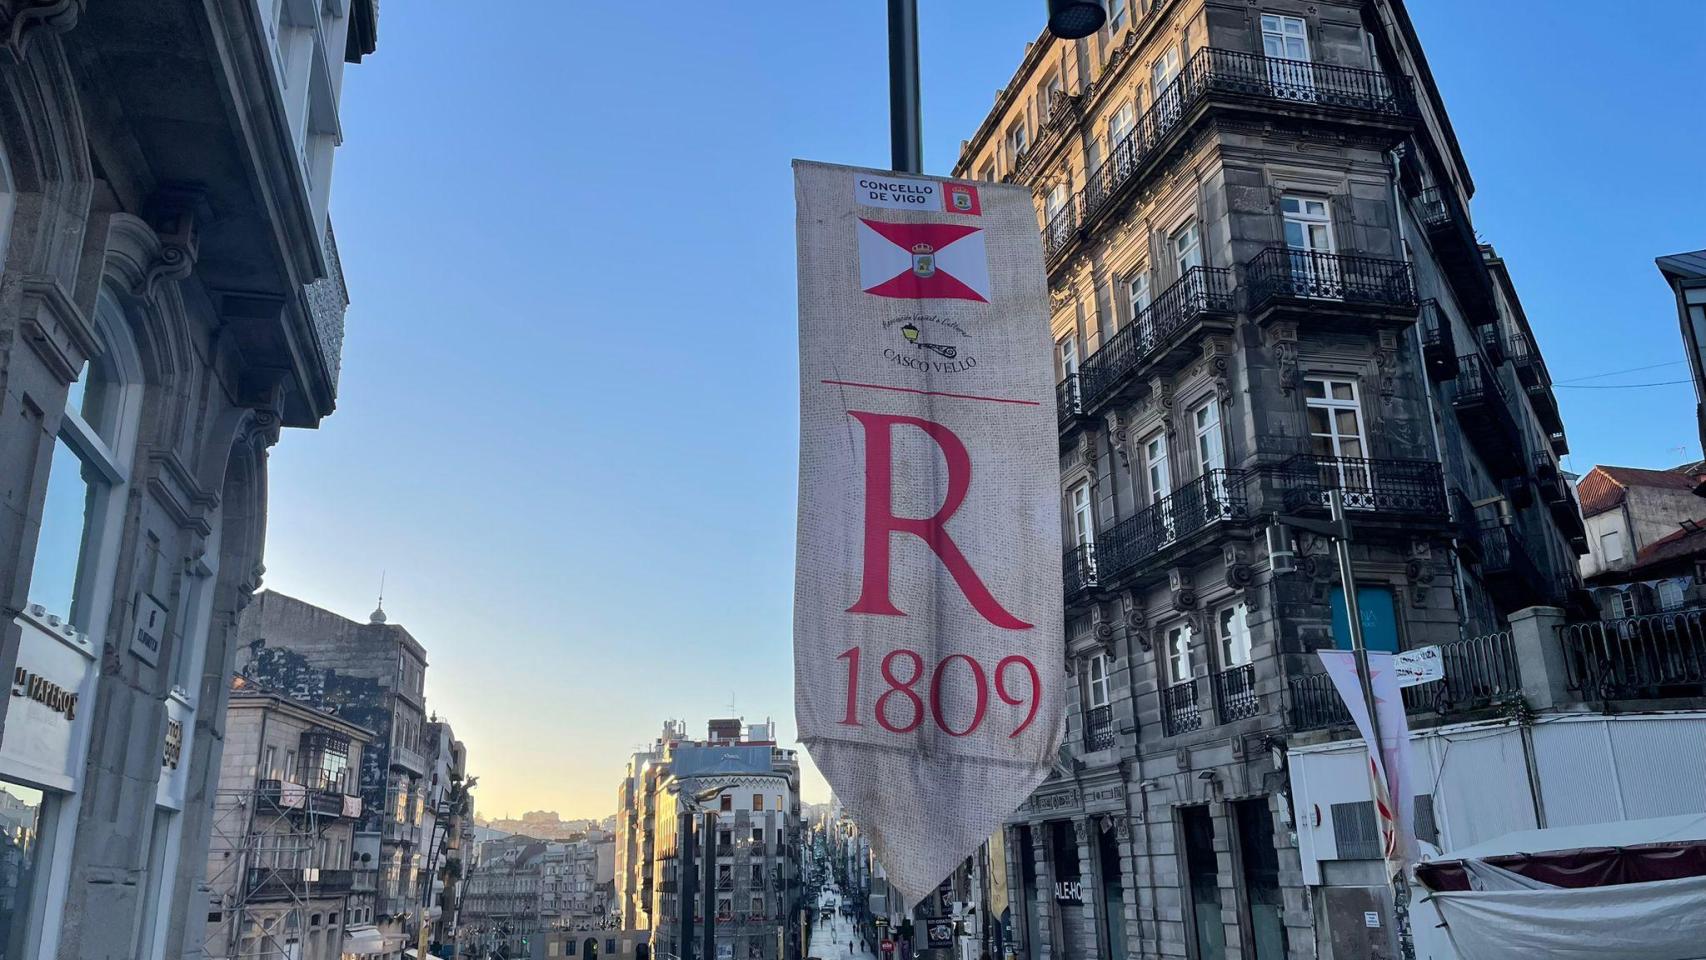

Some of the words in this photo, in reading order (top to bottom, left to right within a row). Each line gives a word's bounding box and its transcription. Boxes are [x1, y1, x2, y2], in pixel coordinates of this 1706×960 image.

[860, 180, 933, 194] CONCELLO
[869, 191, 888, 201] DE
[892, 194, 926, 204] VIGO
[883, 348, 929, 373] CASCO
[933, 356, 977, 373] VELLO
[844, 409, 1035, 630] R
[836, 645, 1042, 739] 1809
[1054, 882, 1085, 900] ALE-HO
